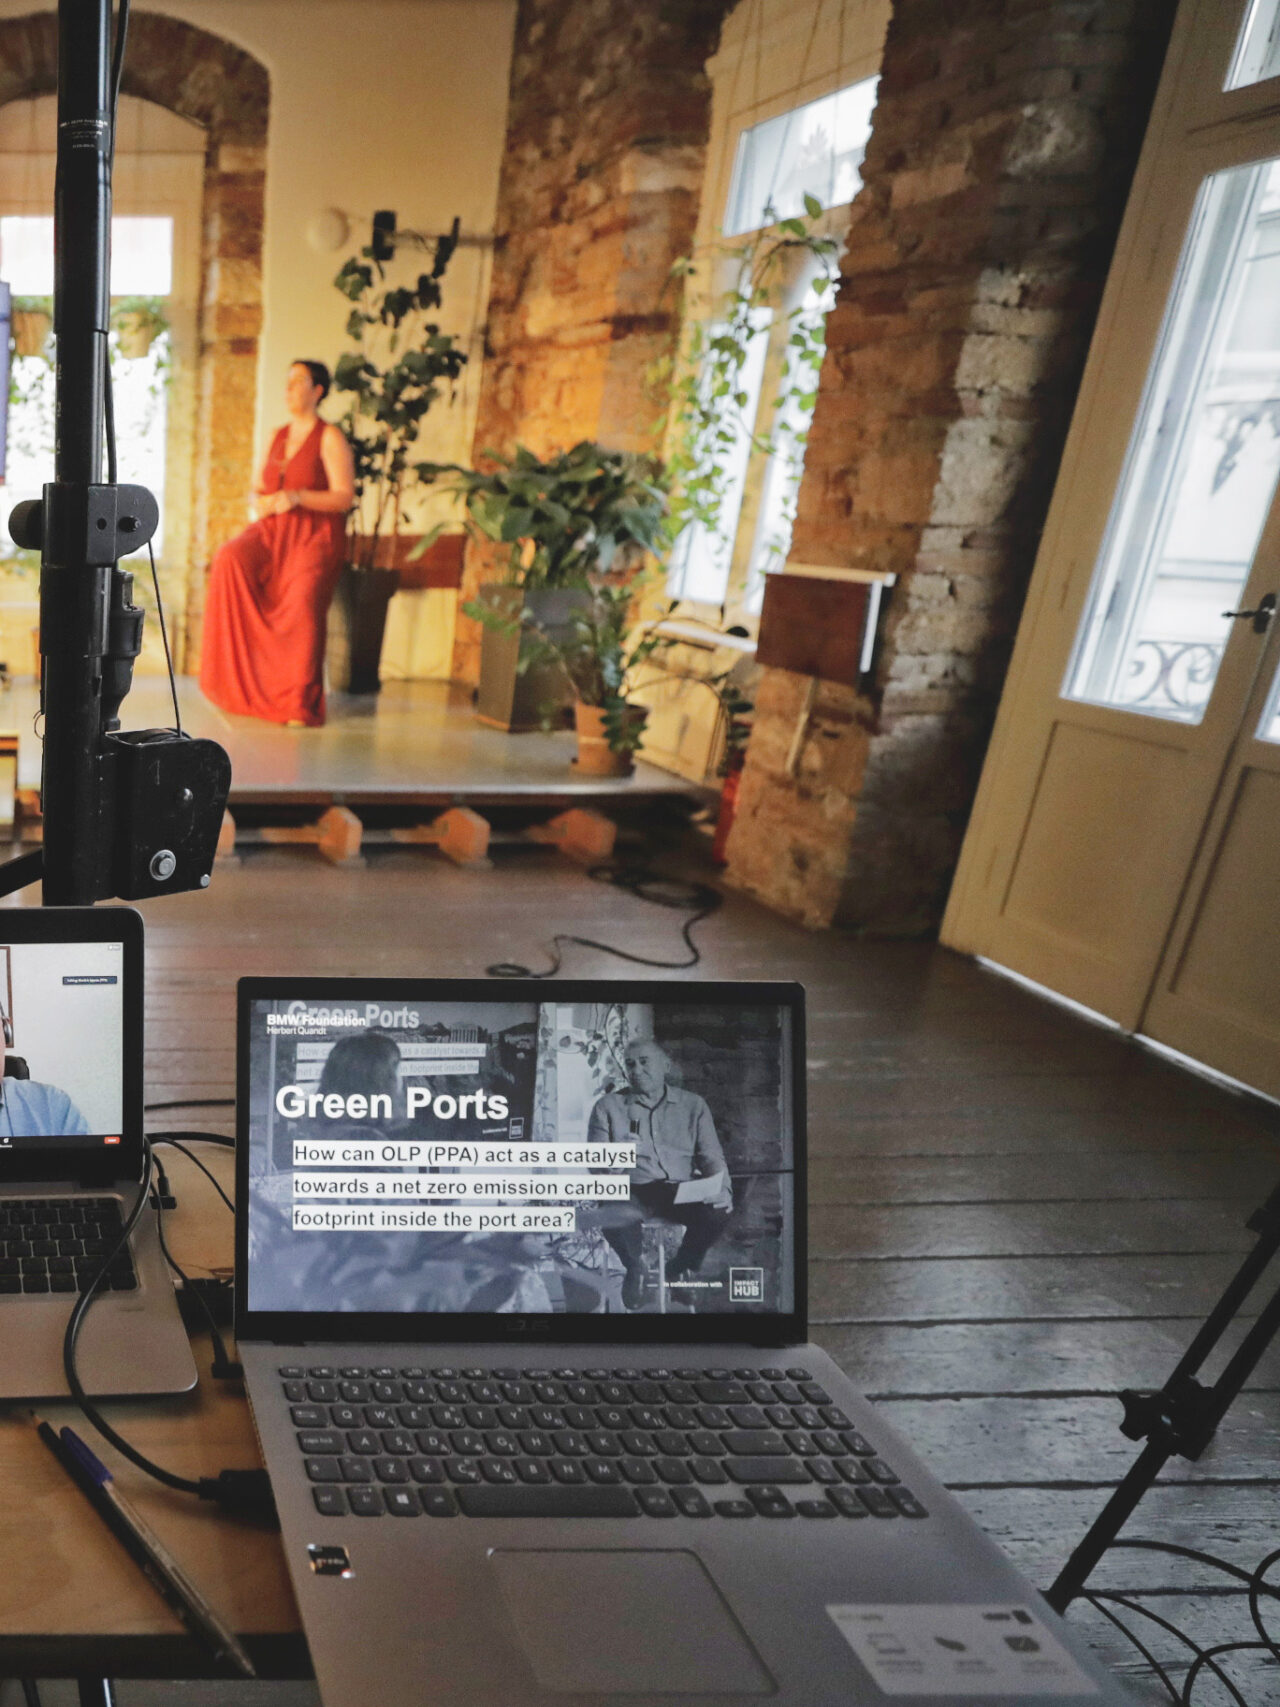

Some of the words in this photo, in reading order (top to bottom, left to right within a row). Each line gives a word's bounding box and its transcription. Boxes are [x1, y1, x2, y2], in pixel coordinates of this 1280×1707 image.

[267, 1014, 300, 1026] BMW
[302, 1014, 366, 1027] Foundation
[365, 1003, 419, 1028] Ports
[266, 1026, 297, 1035] Herbert
[297, 1026, 327, 1035] Quandt
[275, 1084, 393, 1119] Green
[406, 1086, 509, 1120] Ports
[294, 1145, 335, 1161] How
[342, 1149, 375, 1161] can
[381, 1145, 421, 1162] OLP
[427, 1145, 479, 1165] (PPA)
[485, 1148, 513, 1163] act
[519, 1151, 540, 1163] as
[546, 1151, 556, 1163] a
[563, 1148, 637, 1167] catalyst
[294, 1178, 369, 1194] towards
[375, 1182, 386, 1194] a
[393, 1179, 421, 1194] net
[427, 1182, 467, 1194] zero
[473, 1179, 558, 1195] emission
[564, 1180, 629, 1195] carbon
[294, 1210, 375, 1229] footprint
[381, 1211, 437, 1226] inside
[444, 1211, 472, 1226] the
[479, 1213, 516, 1230] port
[522, 1212, 574, 1227] area?
[733, 1286, 760, 1297] HUB
